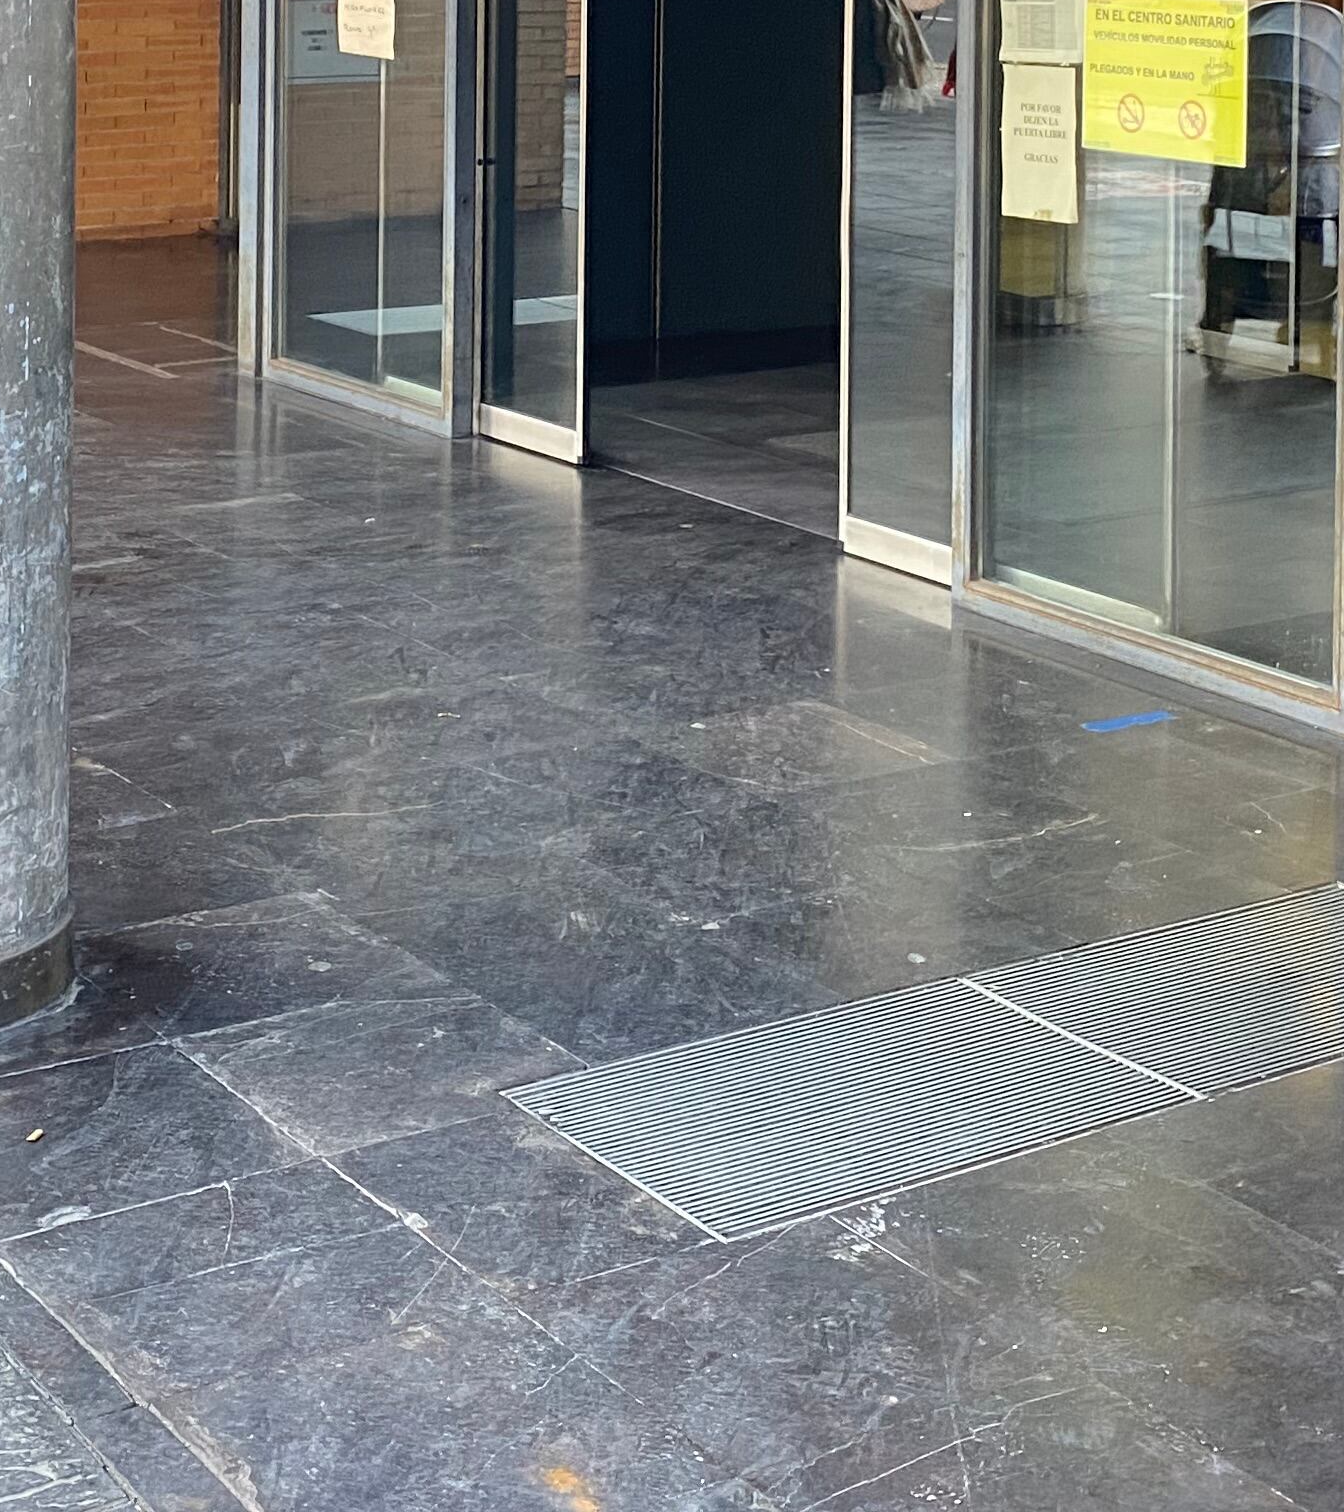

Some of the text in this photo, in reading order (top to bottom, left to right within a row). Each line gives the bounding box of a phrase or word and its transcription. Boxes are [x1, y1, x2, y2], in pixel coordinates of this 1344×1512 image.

[1095, 8, 1236, 30] EN EL CENTRO SANITARIO
[1141, 33, 1187, 47] MOVILIDAD
[1188, 37, 1237, 51] PERSONAL
[1089, 62, 1195, 82] PLEGADOS Y EN LA MANO
[1036, 103, 1061, 114] FAVOR
[1048, 116, 1059, 127] LA
[1024, 152, 1059, 164] GRACIAS
